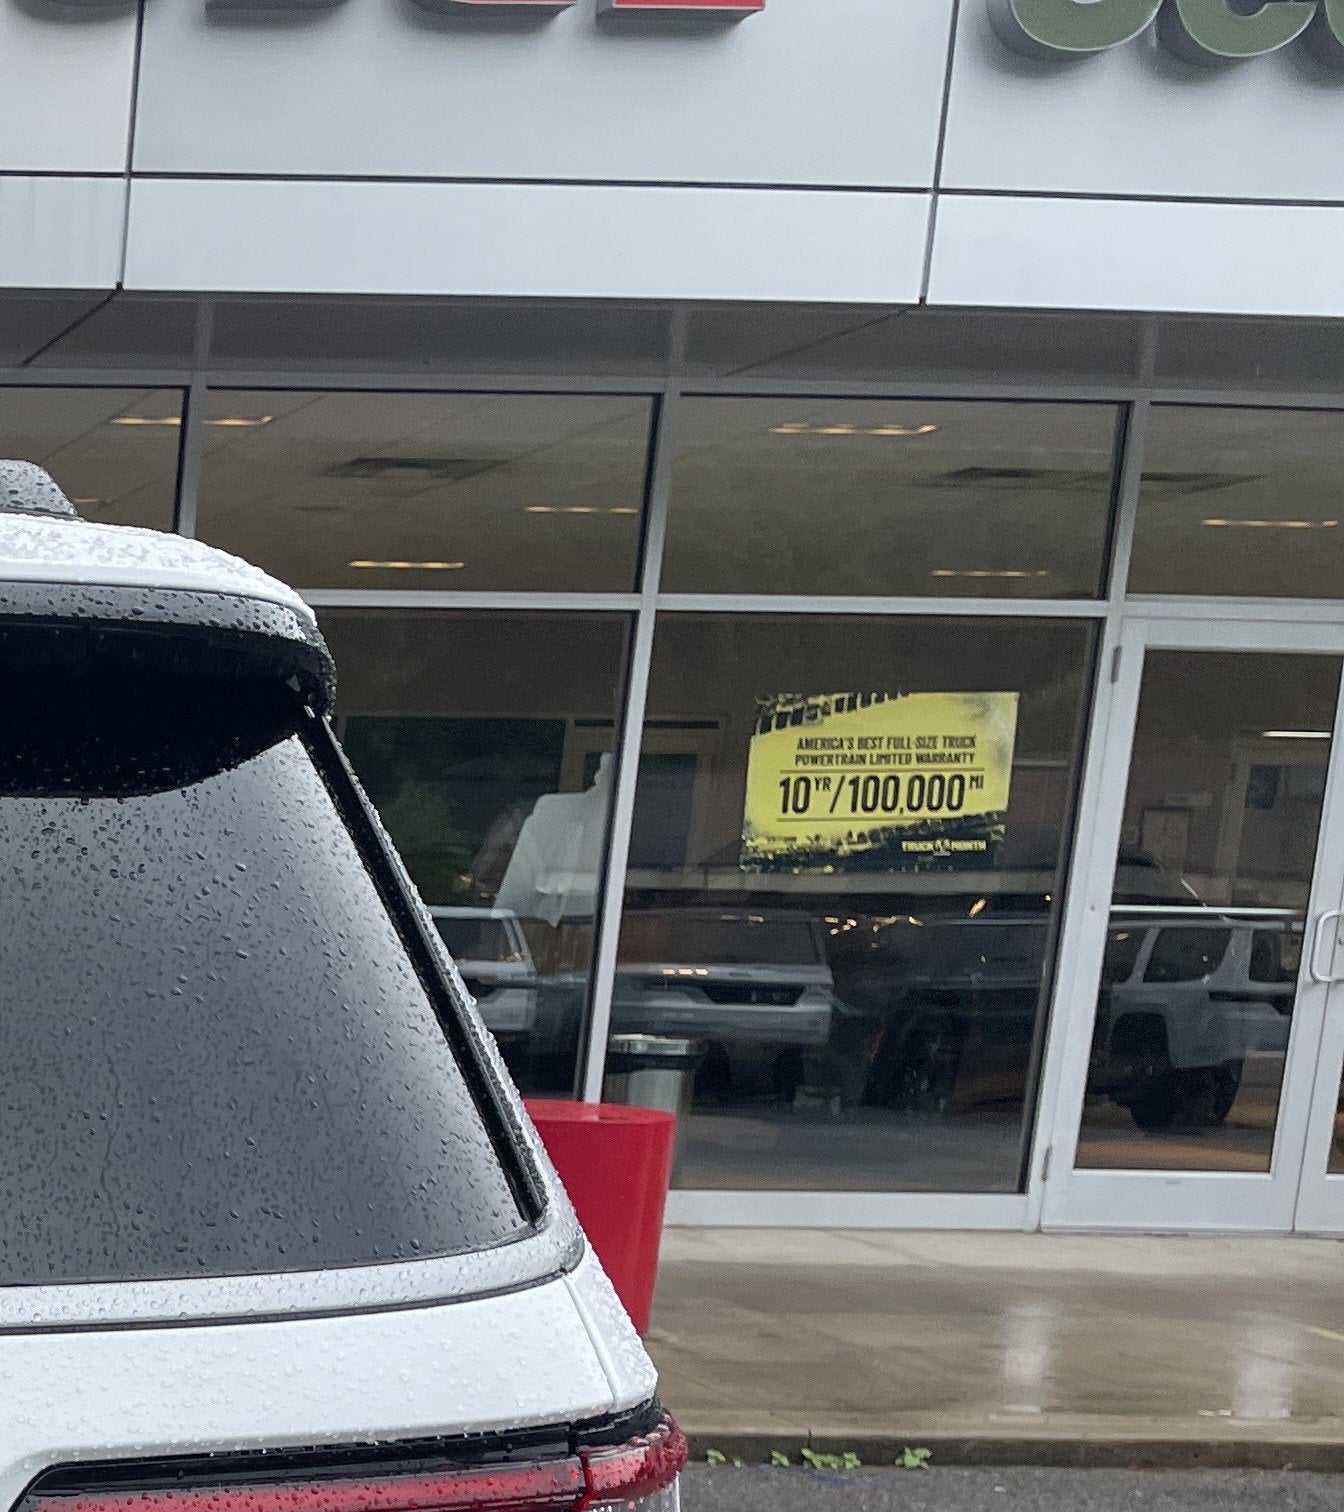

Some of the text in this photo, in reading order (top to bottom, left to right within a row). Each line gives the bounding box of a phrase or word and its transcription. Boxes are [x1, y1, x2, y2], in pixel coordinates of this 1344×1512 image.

[797, 736, 854, 751] AMERICA'S
[857, 736, 885, 751] BEST
[942, 734, 977, 749] TRUCK
[795, 751, 976, 766] POWERTRAIN LIMITED WARRANTY
